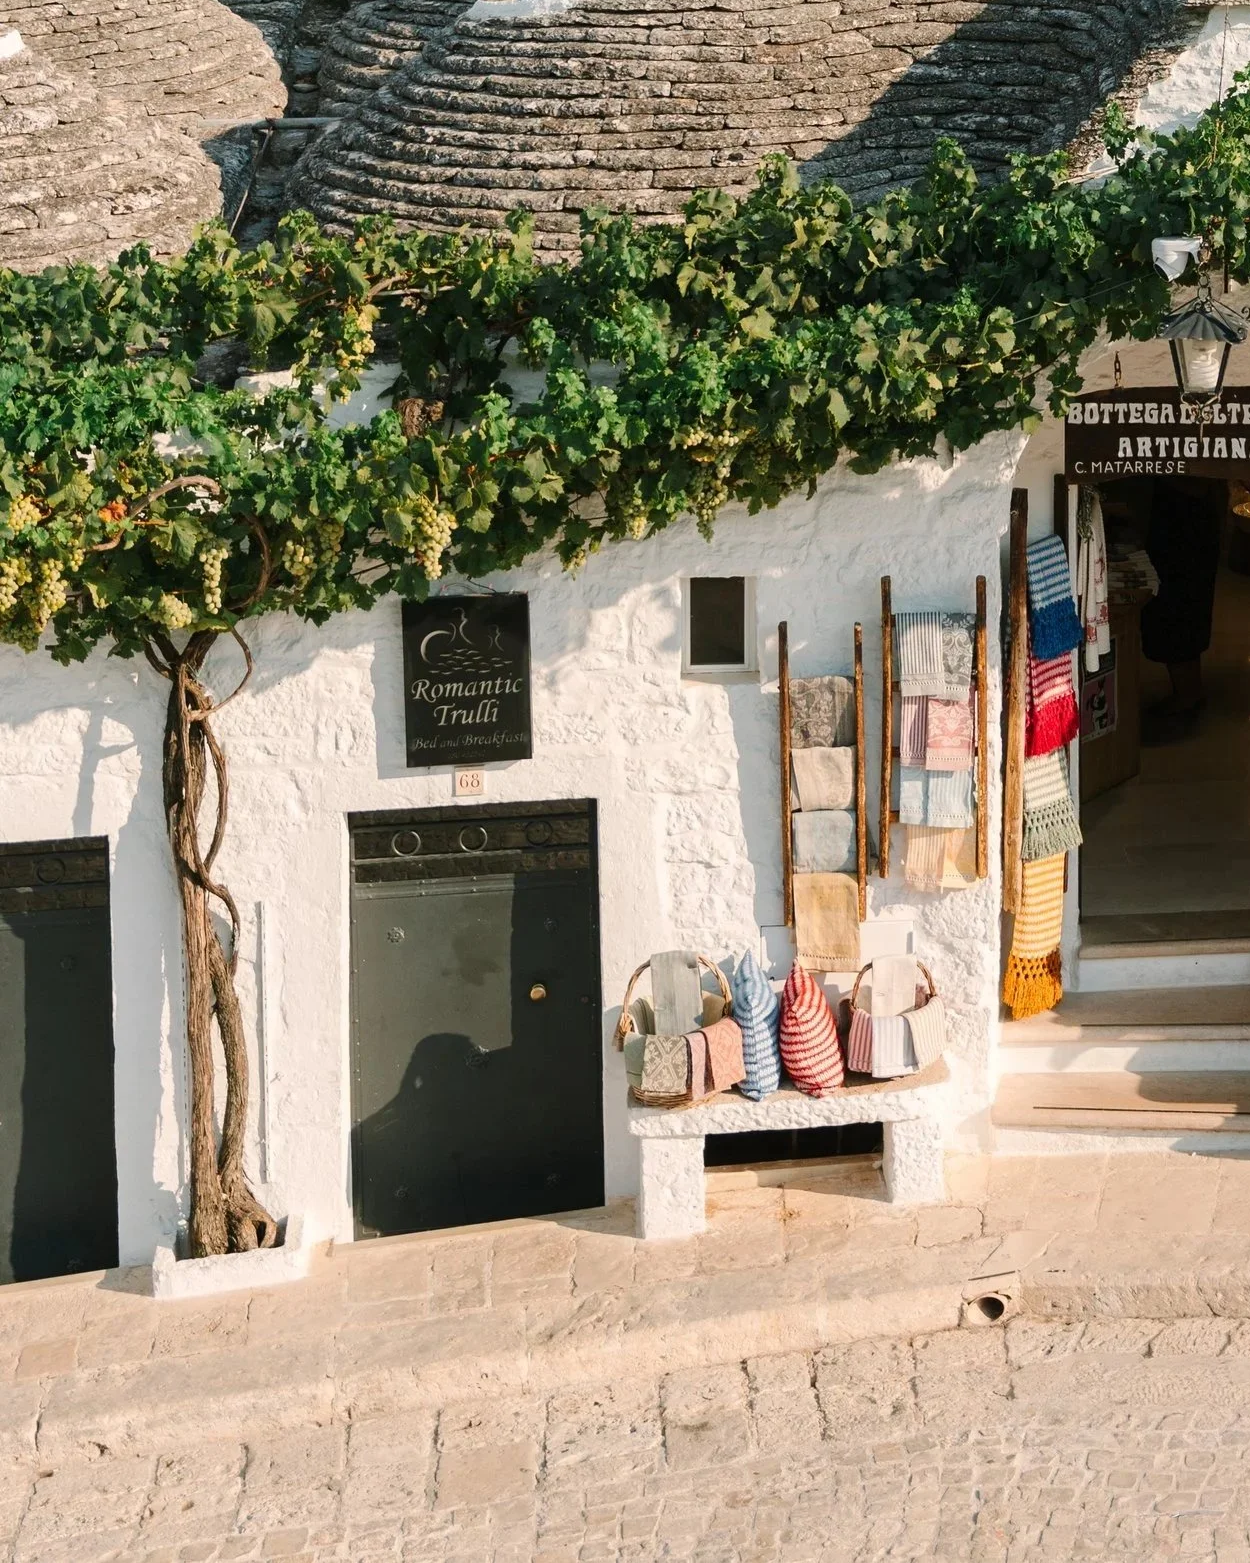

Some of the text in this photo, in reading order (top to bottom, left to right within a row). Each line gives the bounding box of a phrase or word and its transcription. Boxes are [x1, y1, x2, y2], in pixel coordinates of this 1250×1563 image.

[1067, 402, 1176, 425] BOTTEGA
[1074, 460, 1187, 475] C. MATARRESE
[411, 672, 523, 704] Romantic
[433, 699, 500, 726] Trulli
[412, 730, 525, 750] Bed and Breakfast
[459, 772, 481, 789] 68
